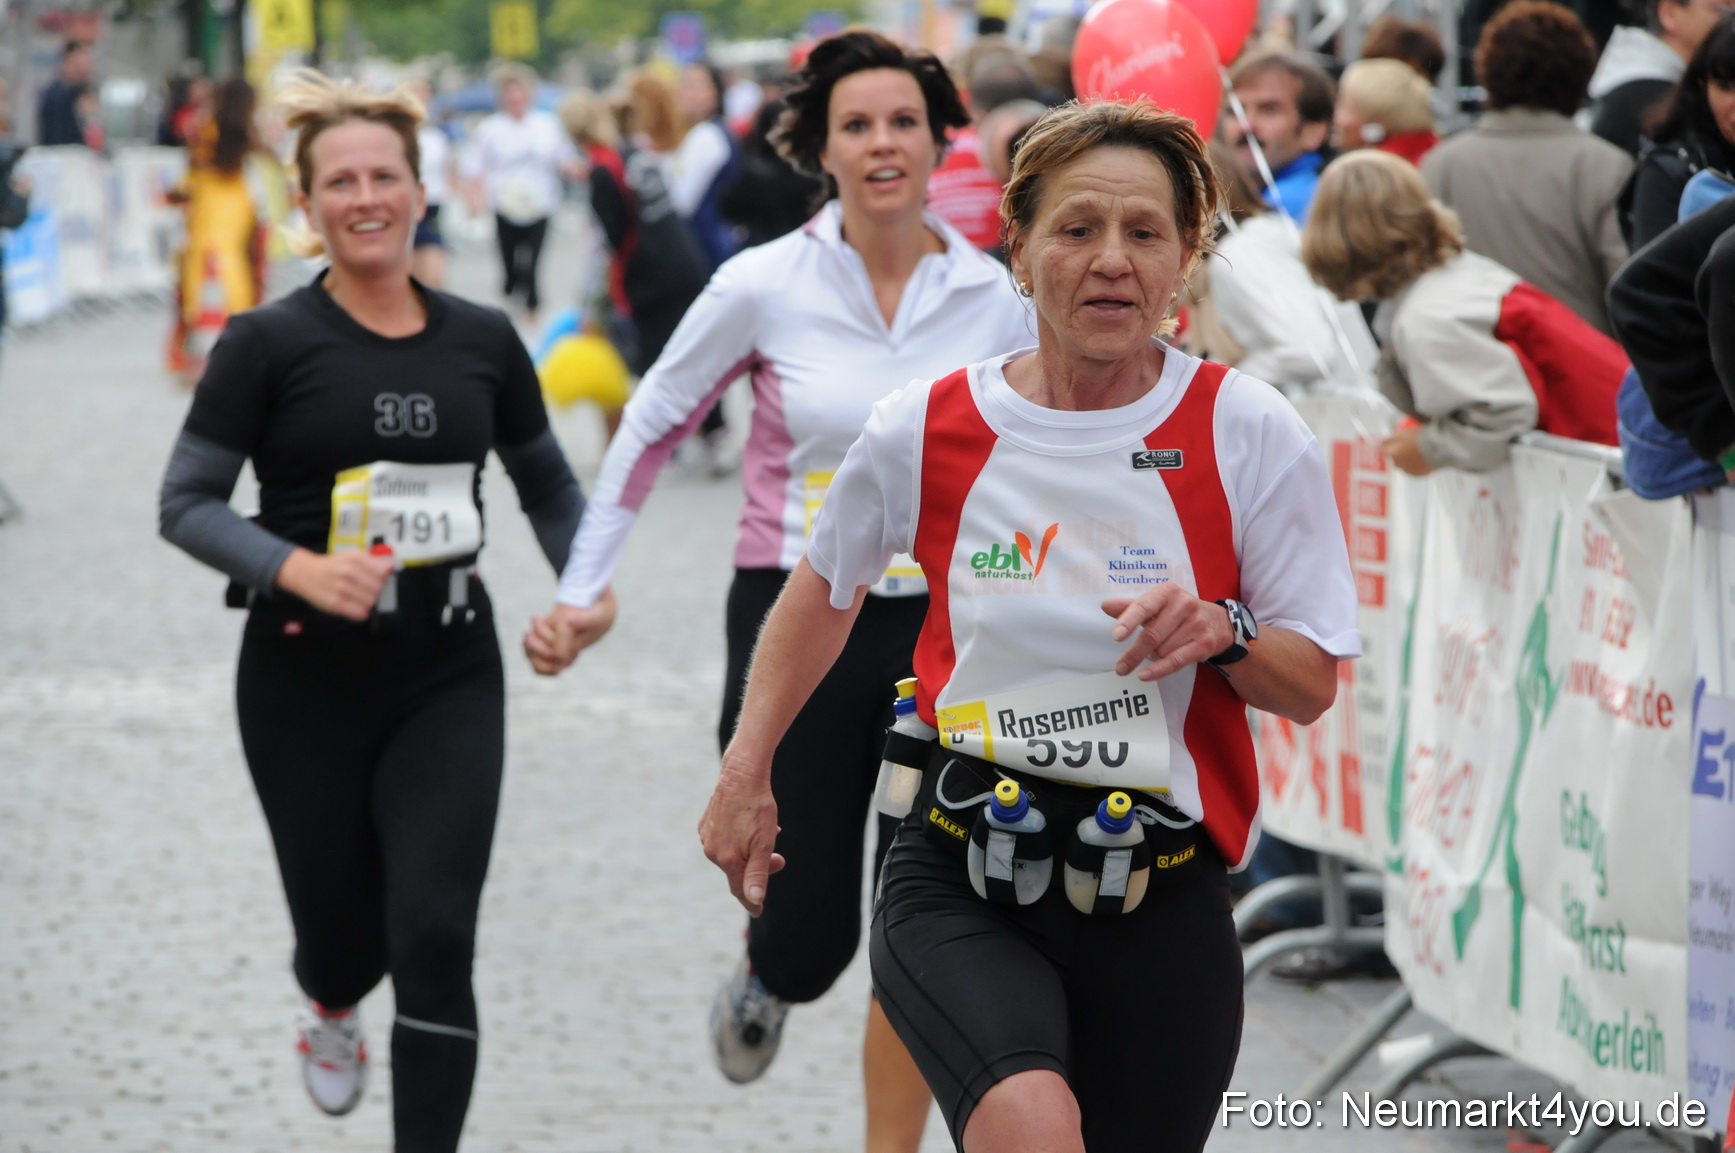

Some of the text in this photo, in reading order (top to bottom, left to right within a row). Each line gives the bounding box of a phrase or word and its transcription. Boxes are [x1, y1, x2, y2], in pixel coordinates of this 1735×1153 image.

[375, 392, 437, 437] 36
[389, 510, 453, 544] 191
[970, 543, 1021, 571] ebl
[1119, 545, 1155, 556] Team
[975, 569, 1033, 581] naturkost
[1108, 560, 1168, 571] Klinikum
[997, 689, 1150, 739] Rosemarie
[936, 814, 967, 839] ALEX
[1169, 845, 1197, 867] ALEX
